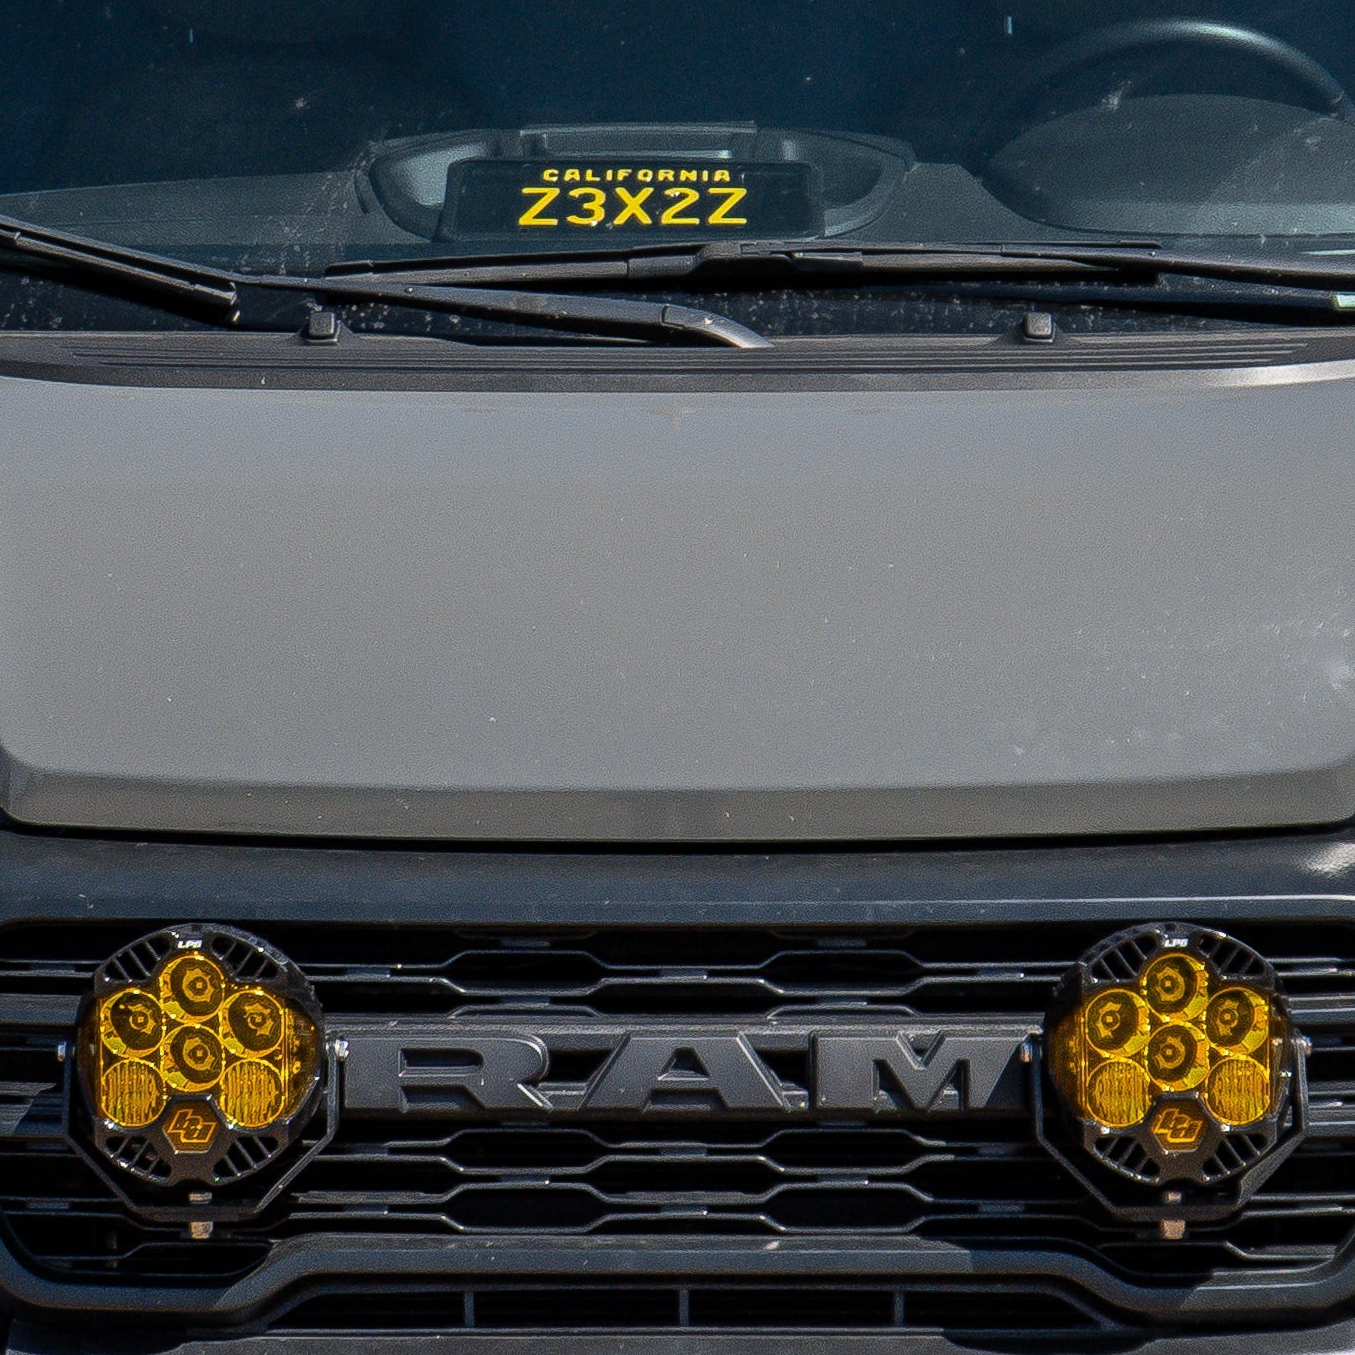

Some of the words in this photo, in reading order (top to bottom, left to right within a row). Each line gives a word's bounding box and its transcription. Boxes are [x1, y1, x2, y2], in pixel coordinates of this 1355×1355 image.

[543, 168, 731, 182] CALIFORNIA
[518, 186, 748, 226] Z3X2Z
[343, 1032, 1029, 1111] RAM
